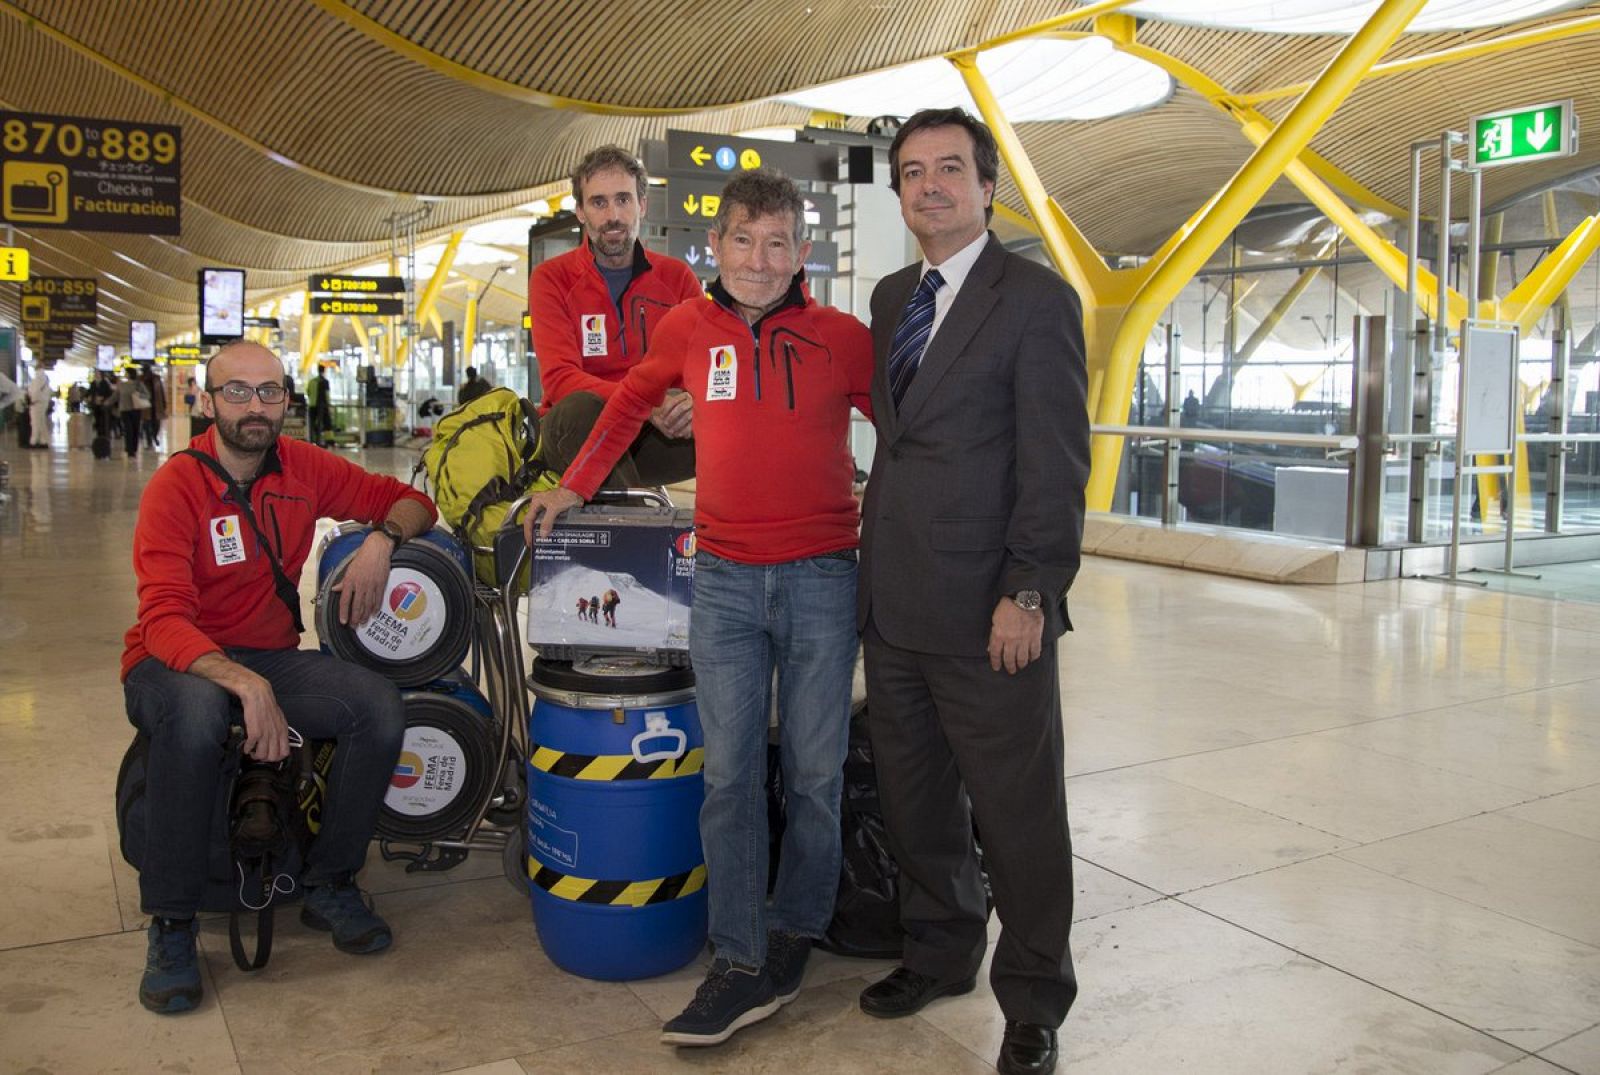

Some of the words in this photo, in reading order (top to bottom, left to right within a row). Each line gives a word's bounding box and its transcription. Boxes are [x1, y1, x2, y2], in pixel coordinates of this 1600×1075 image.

[3, 119, 84, 157] 870
[101, 128, 177, 165] 889
[97, 181, 154, 197] Check-in
[74, 196, 176, 217] Facturación
[370, 621, 390, 638] Feria
[376, 610, 409, 637] IFEMA
[366, 628, 400, 652] Madrid
[423, 755, 437, 789] IFEMA
[435, 770, 446, 791] Feria
[443, 756, 457, 791] Madrid
